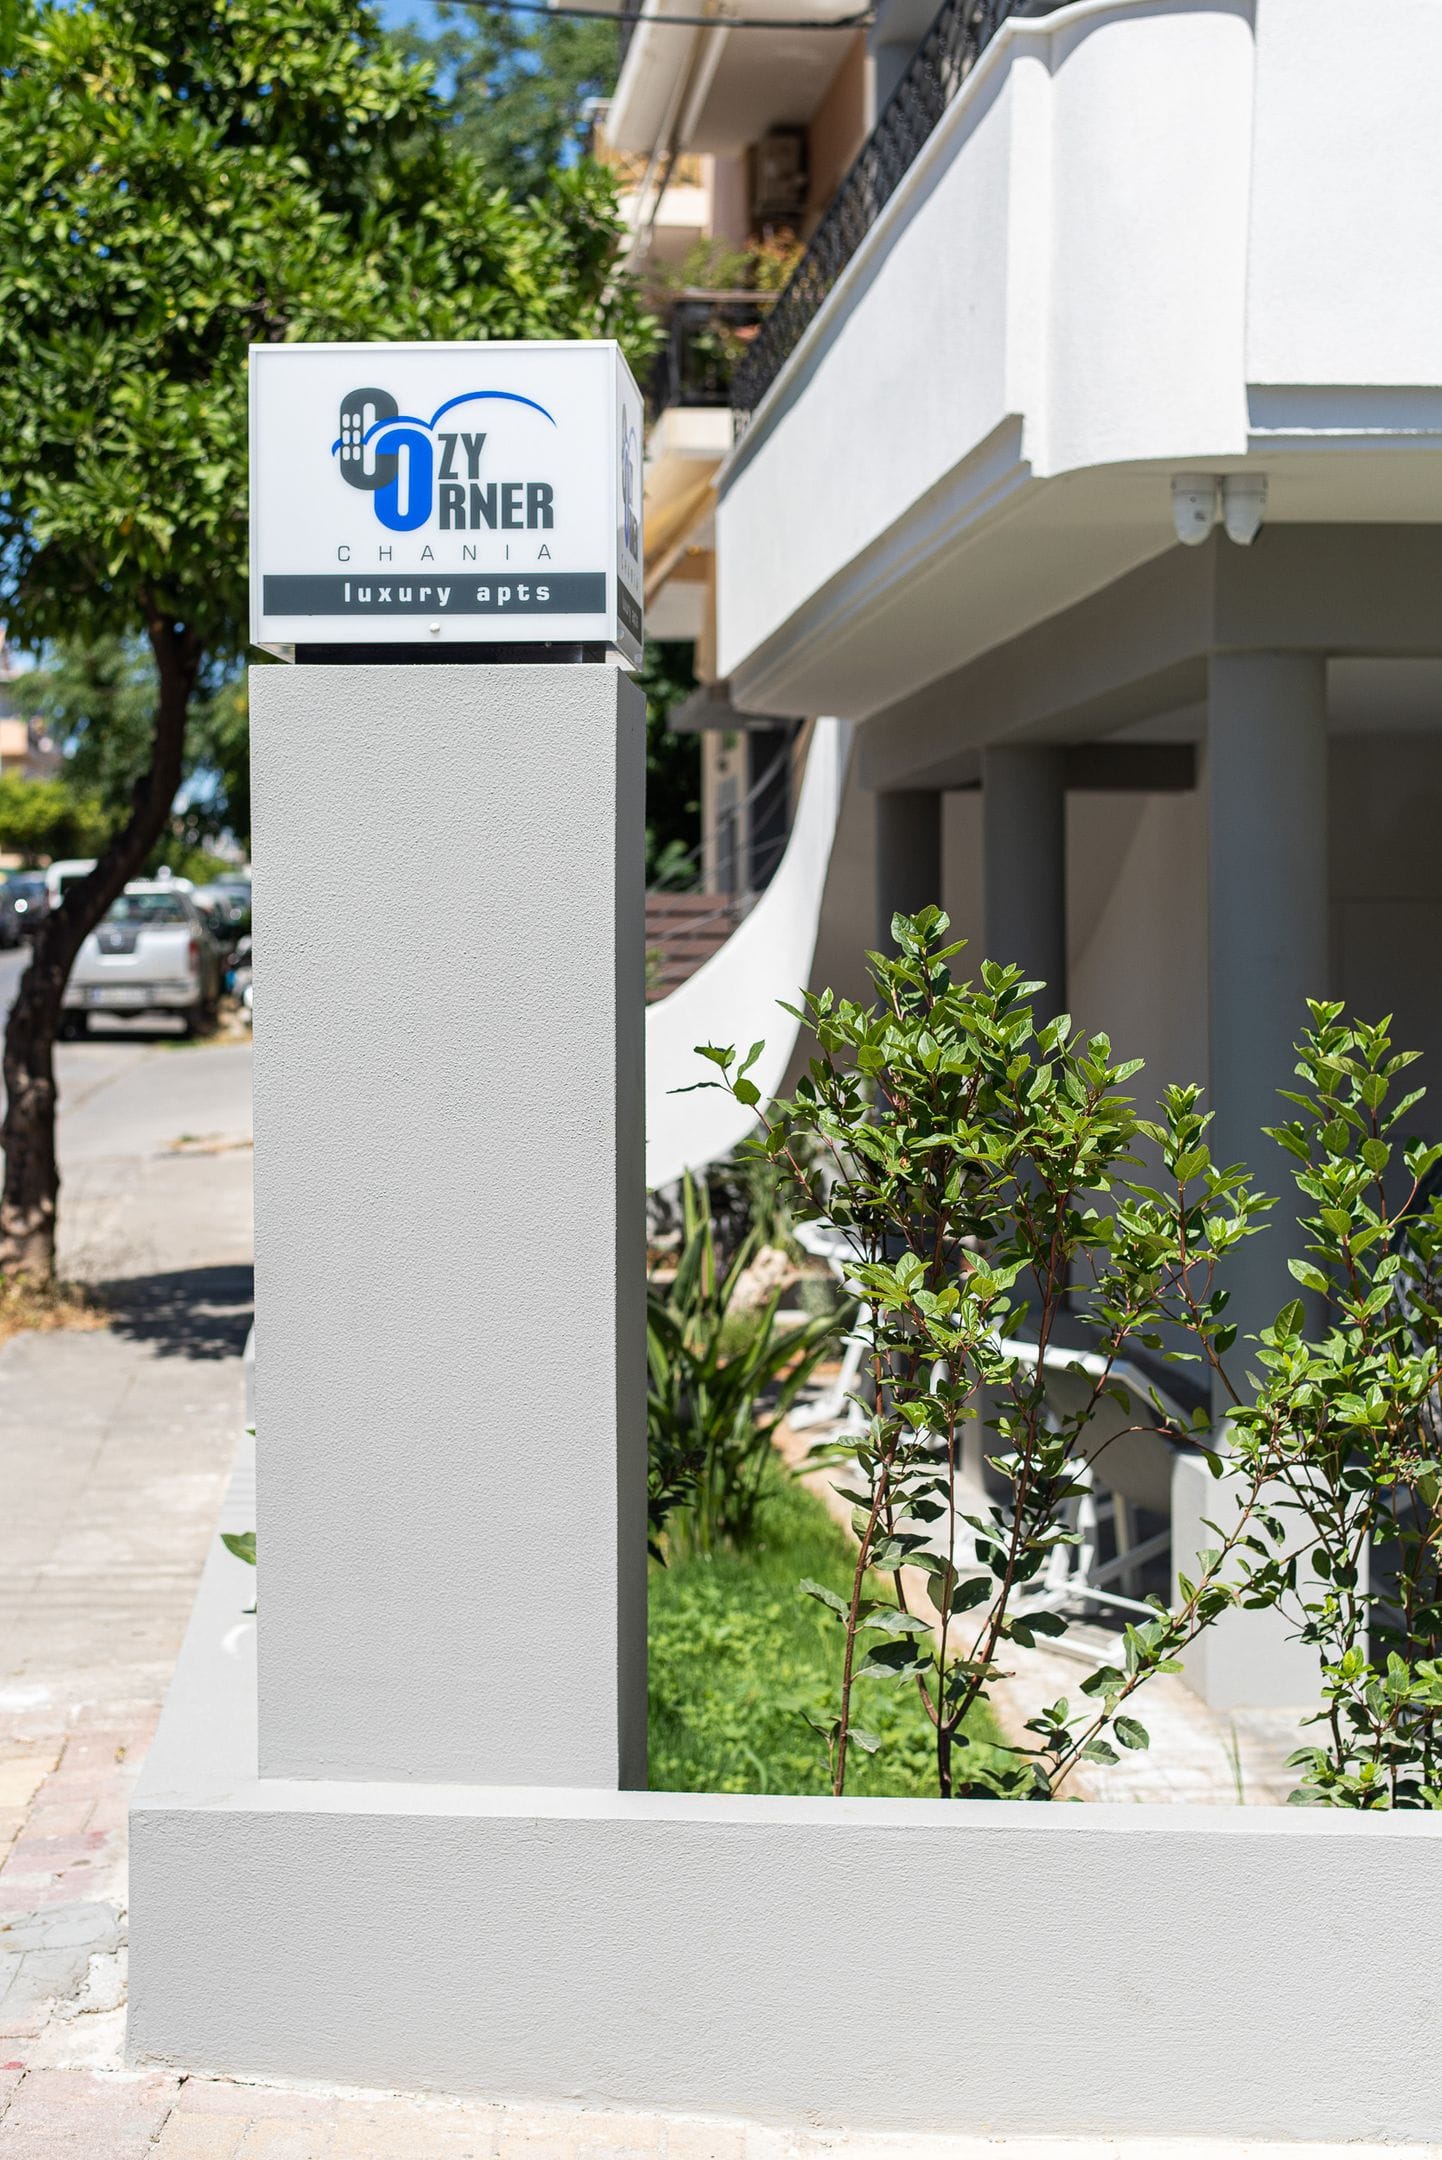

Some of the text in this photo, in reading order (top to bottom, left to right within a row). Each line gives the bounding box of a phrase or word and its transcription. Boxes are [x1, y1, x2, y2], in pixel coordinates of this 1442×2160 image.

[337, 544, 551, 561] CHANIA
[344, 582, 550, 606] luxury apts
